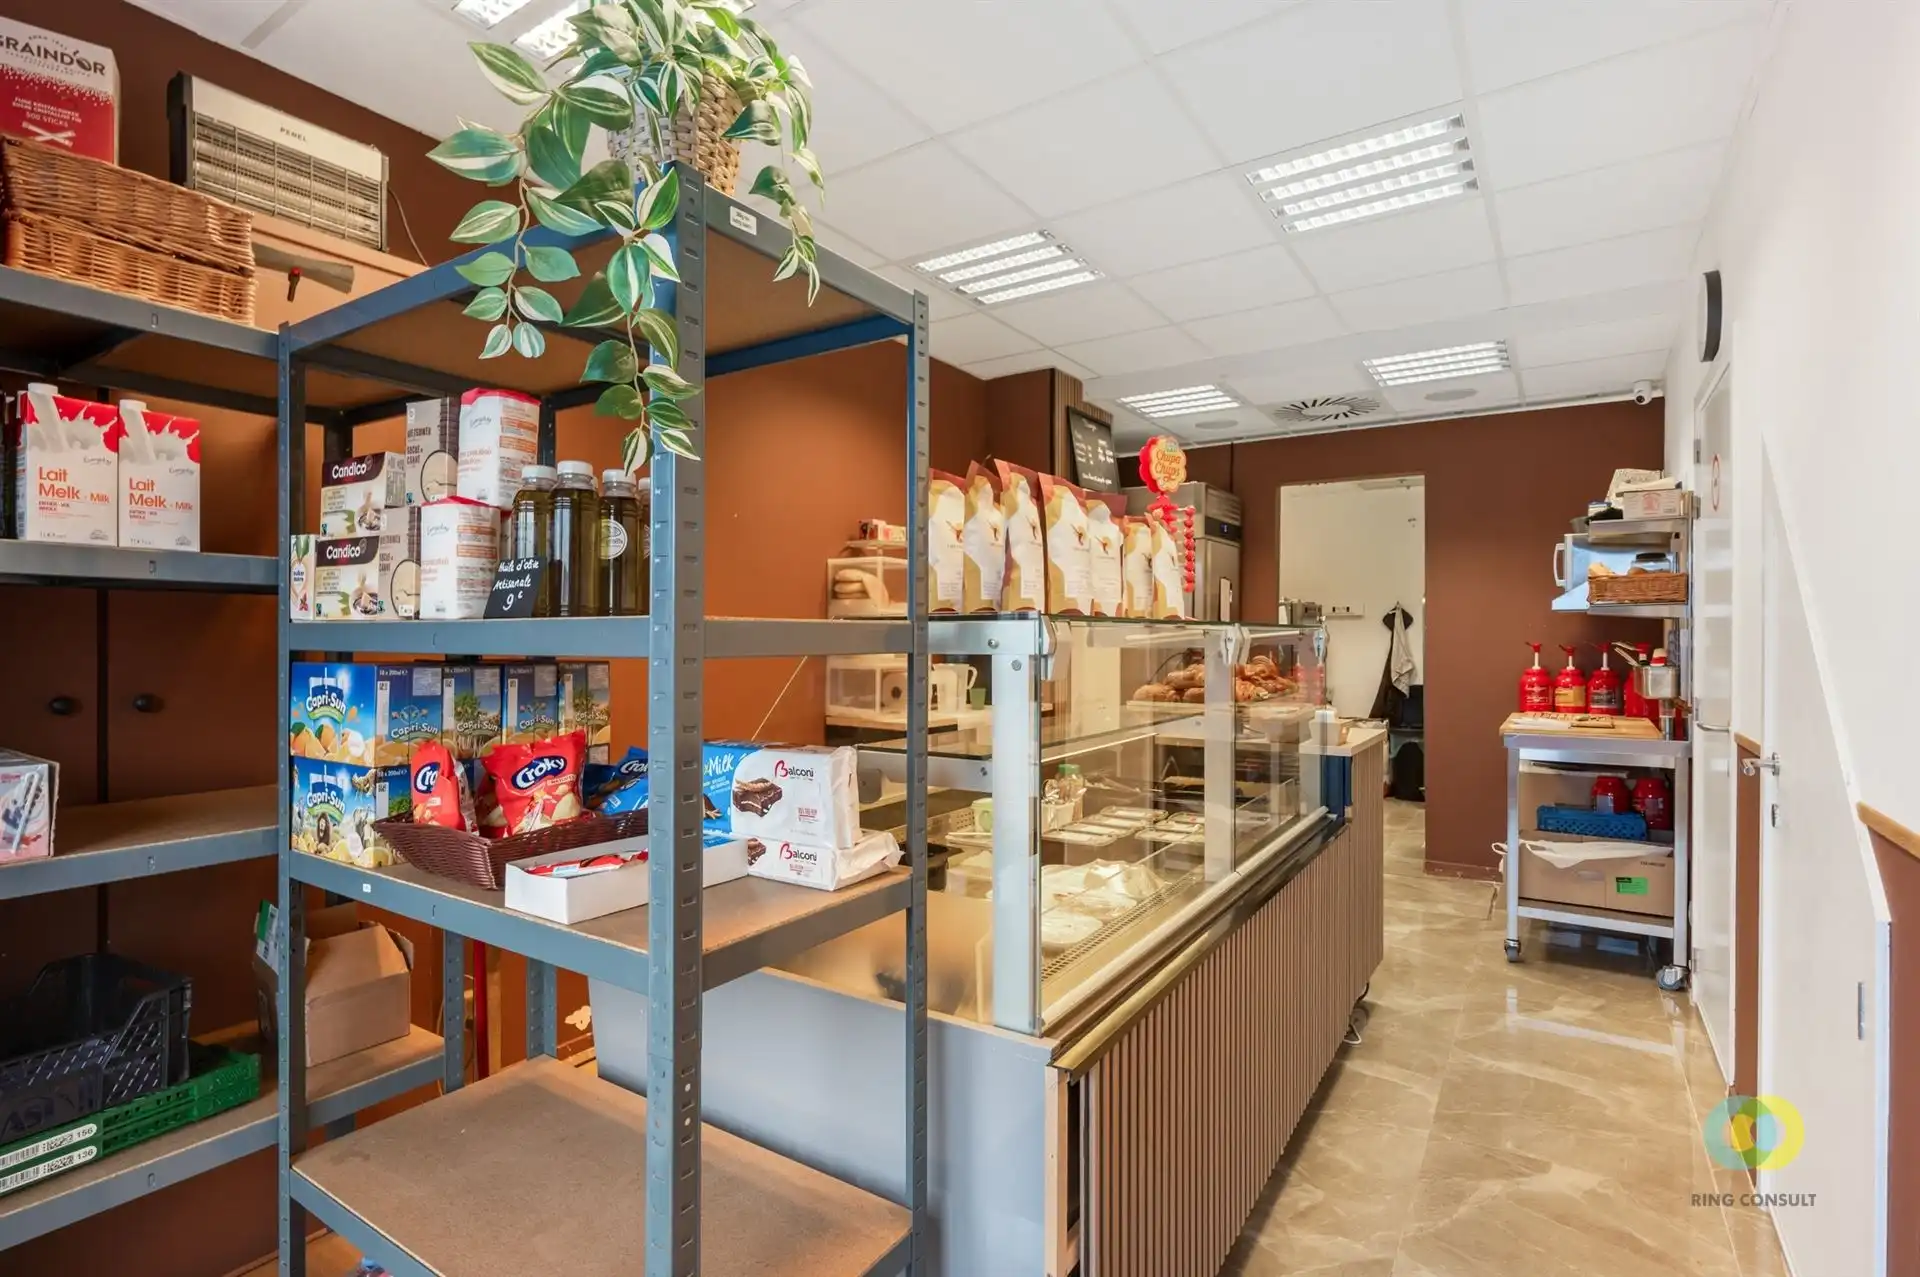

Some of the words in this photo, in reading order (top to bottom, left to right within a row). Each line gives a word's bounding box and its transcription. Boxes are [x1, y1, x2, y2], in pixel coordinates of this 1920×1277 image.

[1156, 449, 1182, 465] Chupa
[39, 466, 68, 482] Lait
[332, 461, 367, 480] Candico
[1155, 461, 1181, 481] Chups
[39, 483, 80, 500] Melk
[89, 492, 110, 503] Milk
[129, 477, 155, 492] Lait
[129, 493, 167, 509] Melk
[175, 501, 193, 511] Milk
[326, 544, 361, 560] Candico
[306, 690, 347, 715] Capri-Sun
[391, 722, 438, 739] Capri-Sun
[456, 720, 499, 733] Capri-Sun
[519, 713, 556, 730] Capri-Sun
[515, 757, 566, 789] Croky
[774, 759, 815, 778] Balconi
[306, 788, 346, 814] Capri-Sun
[779, 842, 819, 863] Balconi
[76, 1127, 94, 1139] 156
